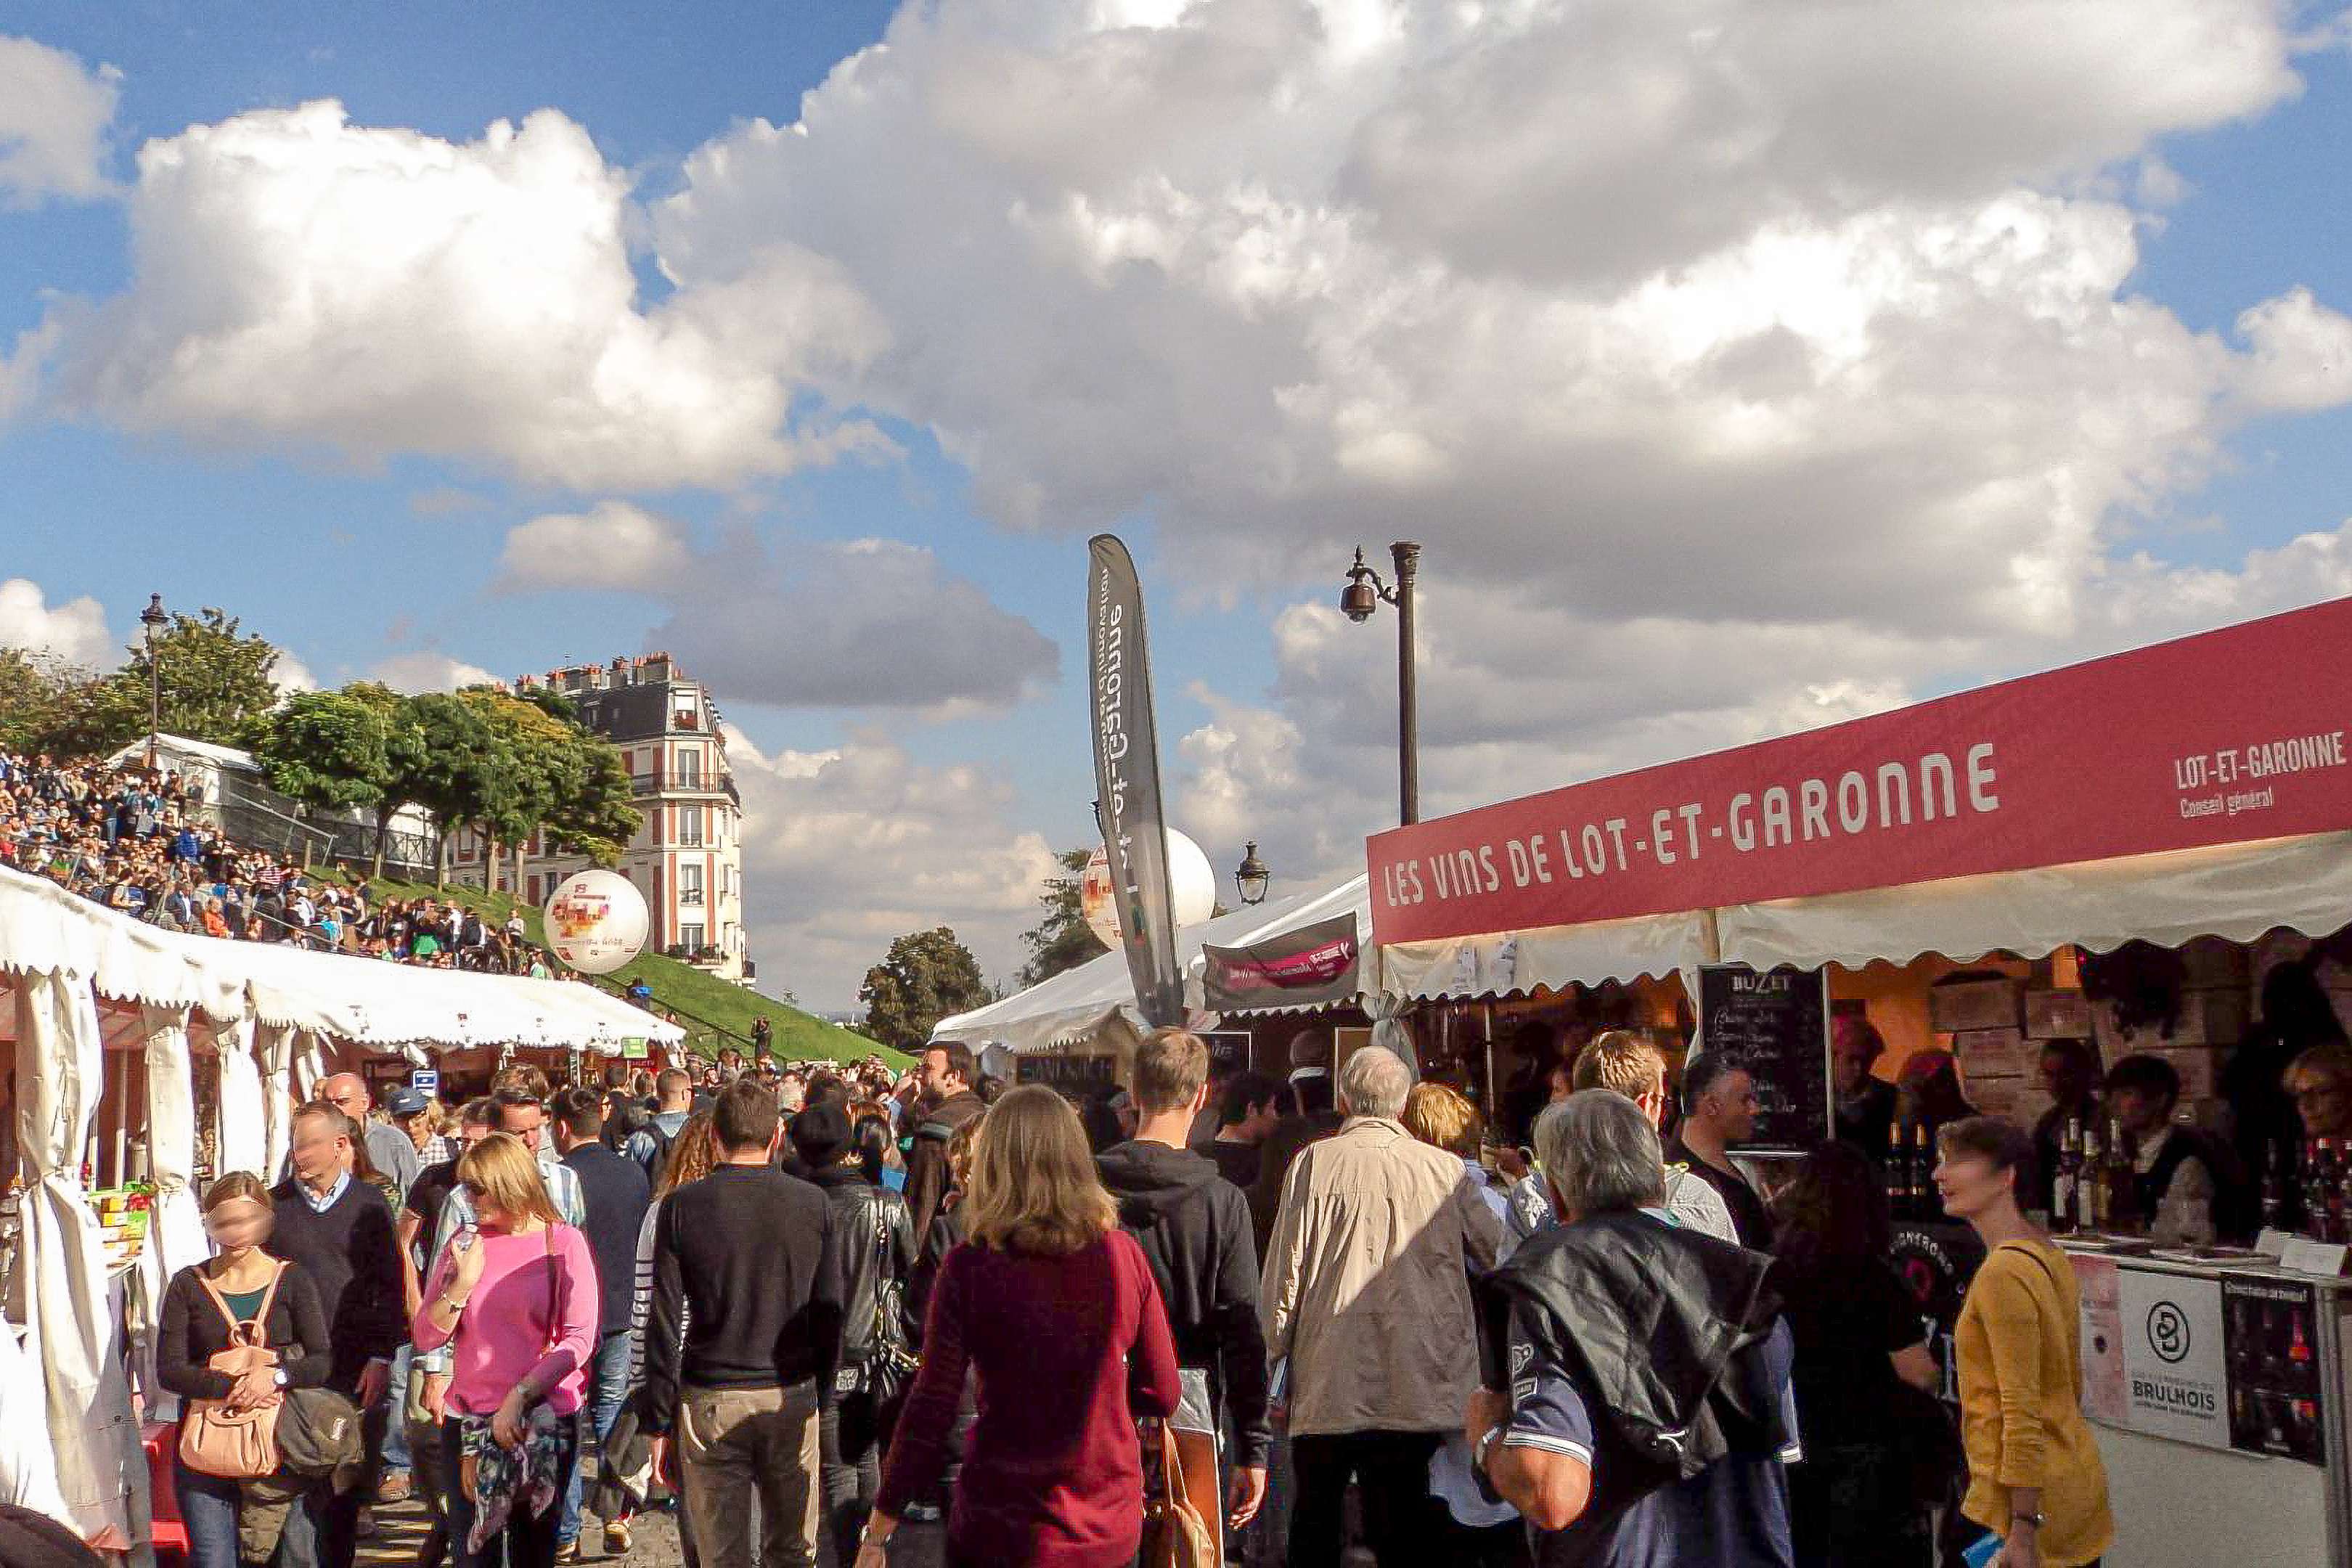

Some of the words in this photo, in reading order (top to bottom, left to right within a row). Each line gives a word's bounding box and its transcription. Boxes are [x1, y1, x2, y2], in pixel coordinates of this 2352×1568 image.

[2175, 732, 2347, 790] LOT-ET-GARONNE
[1384, 859, 1424, 907] LES
[1429, 845, 1500, 899] VINS
[1506, 836, 1553, 887] DE
[1560, 743, 2001, 878] LOT-ET-GARONNE
[2131, 1379, 2216, 1411] BRULHOIS
